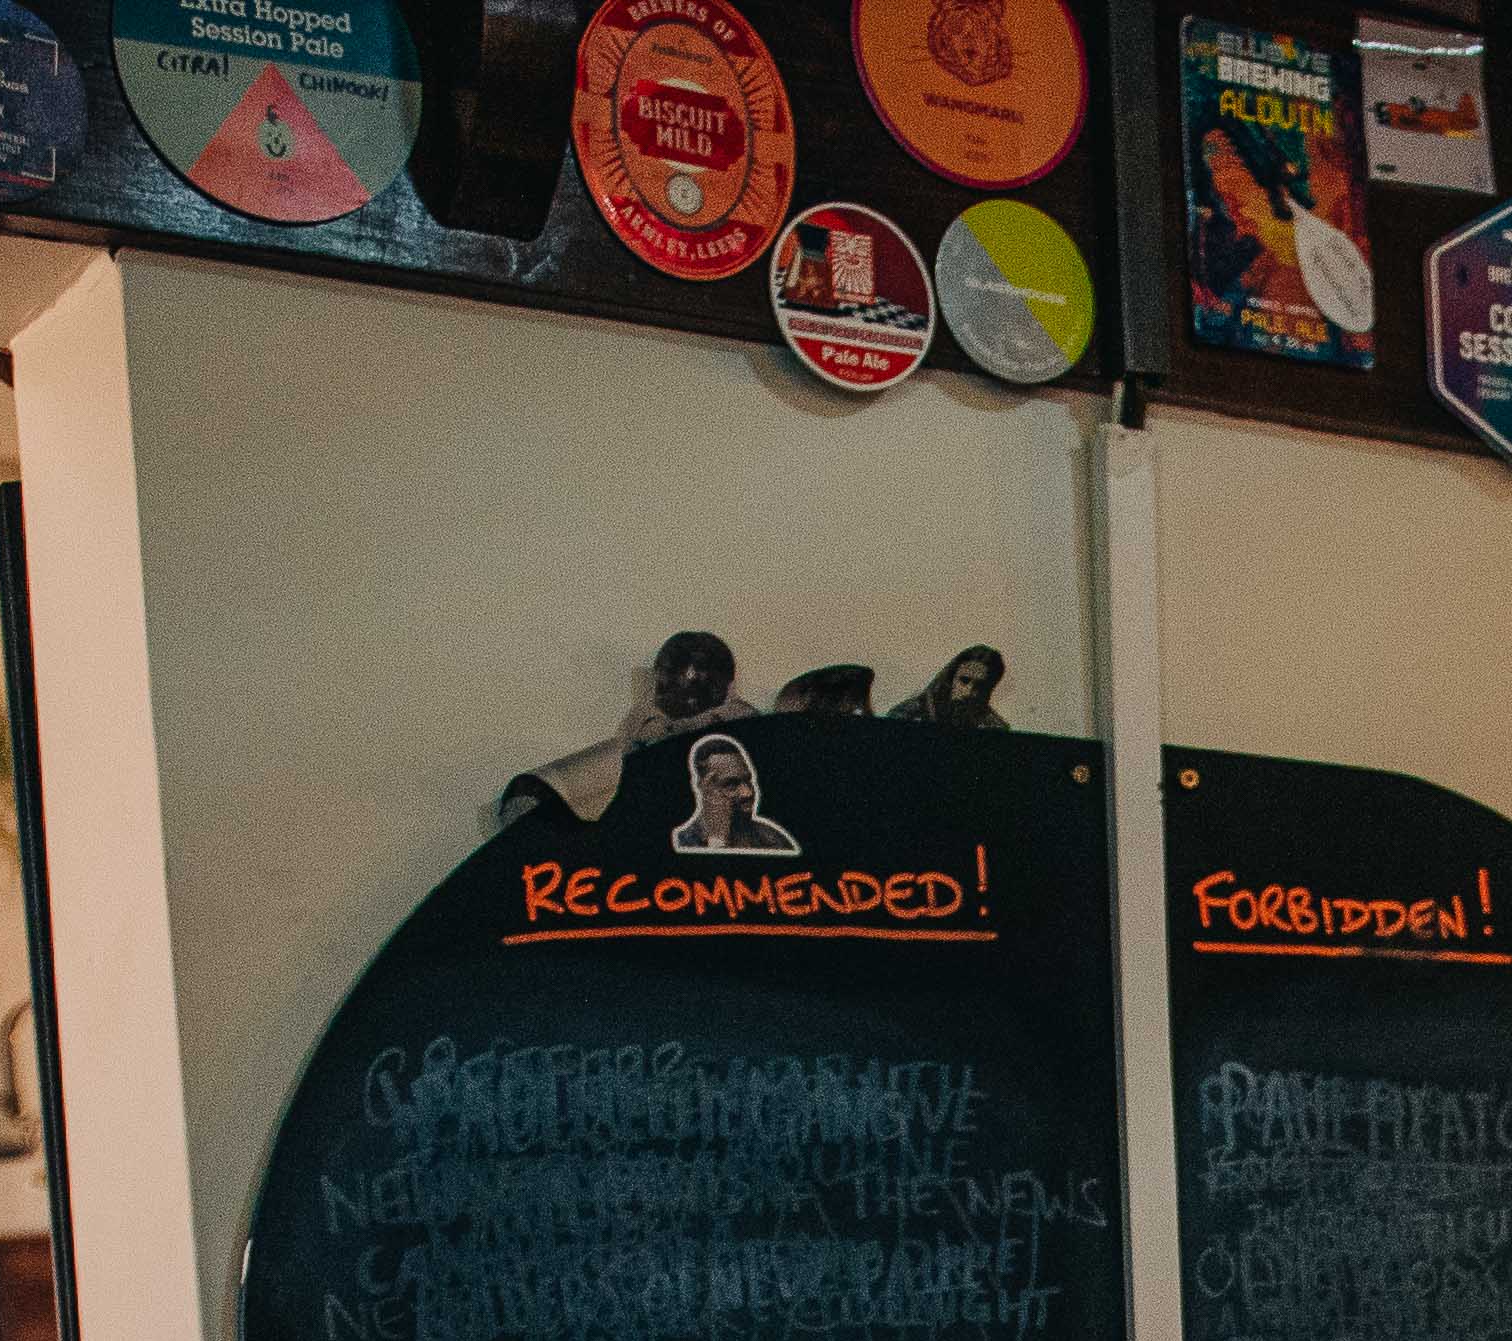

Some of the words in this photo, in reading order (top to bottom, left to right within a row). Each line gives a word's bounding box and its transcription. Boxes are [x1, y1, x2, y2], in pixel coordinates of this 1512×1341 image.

[255, 2, 351, 33] Hopped
[191, 18, 282, 50] Session
[288, 33, 344, 58] Pale
[1217, 56, 1332, 99] BREWING
[638, 95, 728, 134] BISCUIT
[656, 125, 713, 157] MILD
[1240, 309, 1285, 336] PALE
[1295, 318, 1330, 342] ALE
[822, 345, 856, 367] Pale
[861, 351, 889, 371] Ale
[522, 845, 989, 923] RECOMMENDED!
[1193, 868, 1494, 940] FORBIDDEN!
